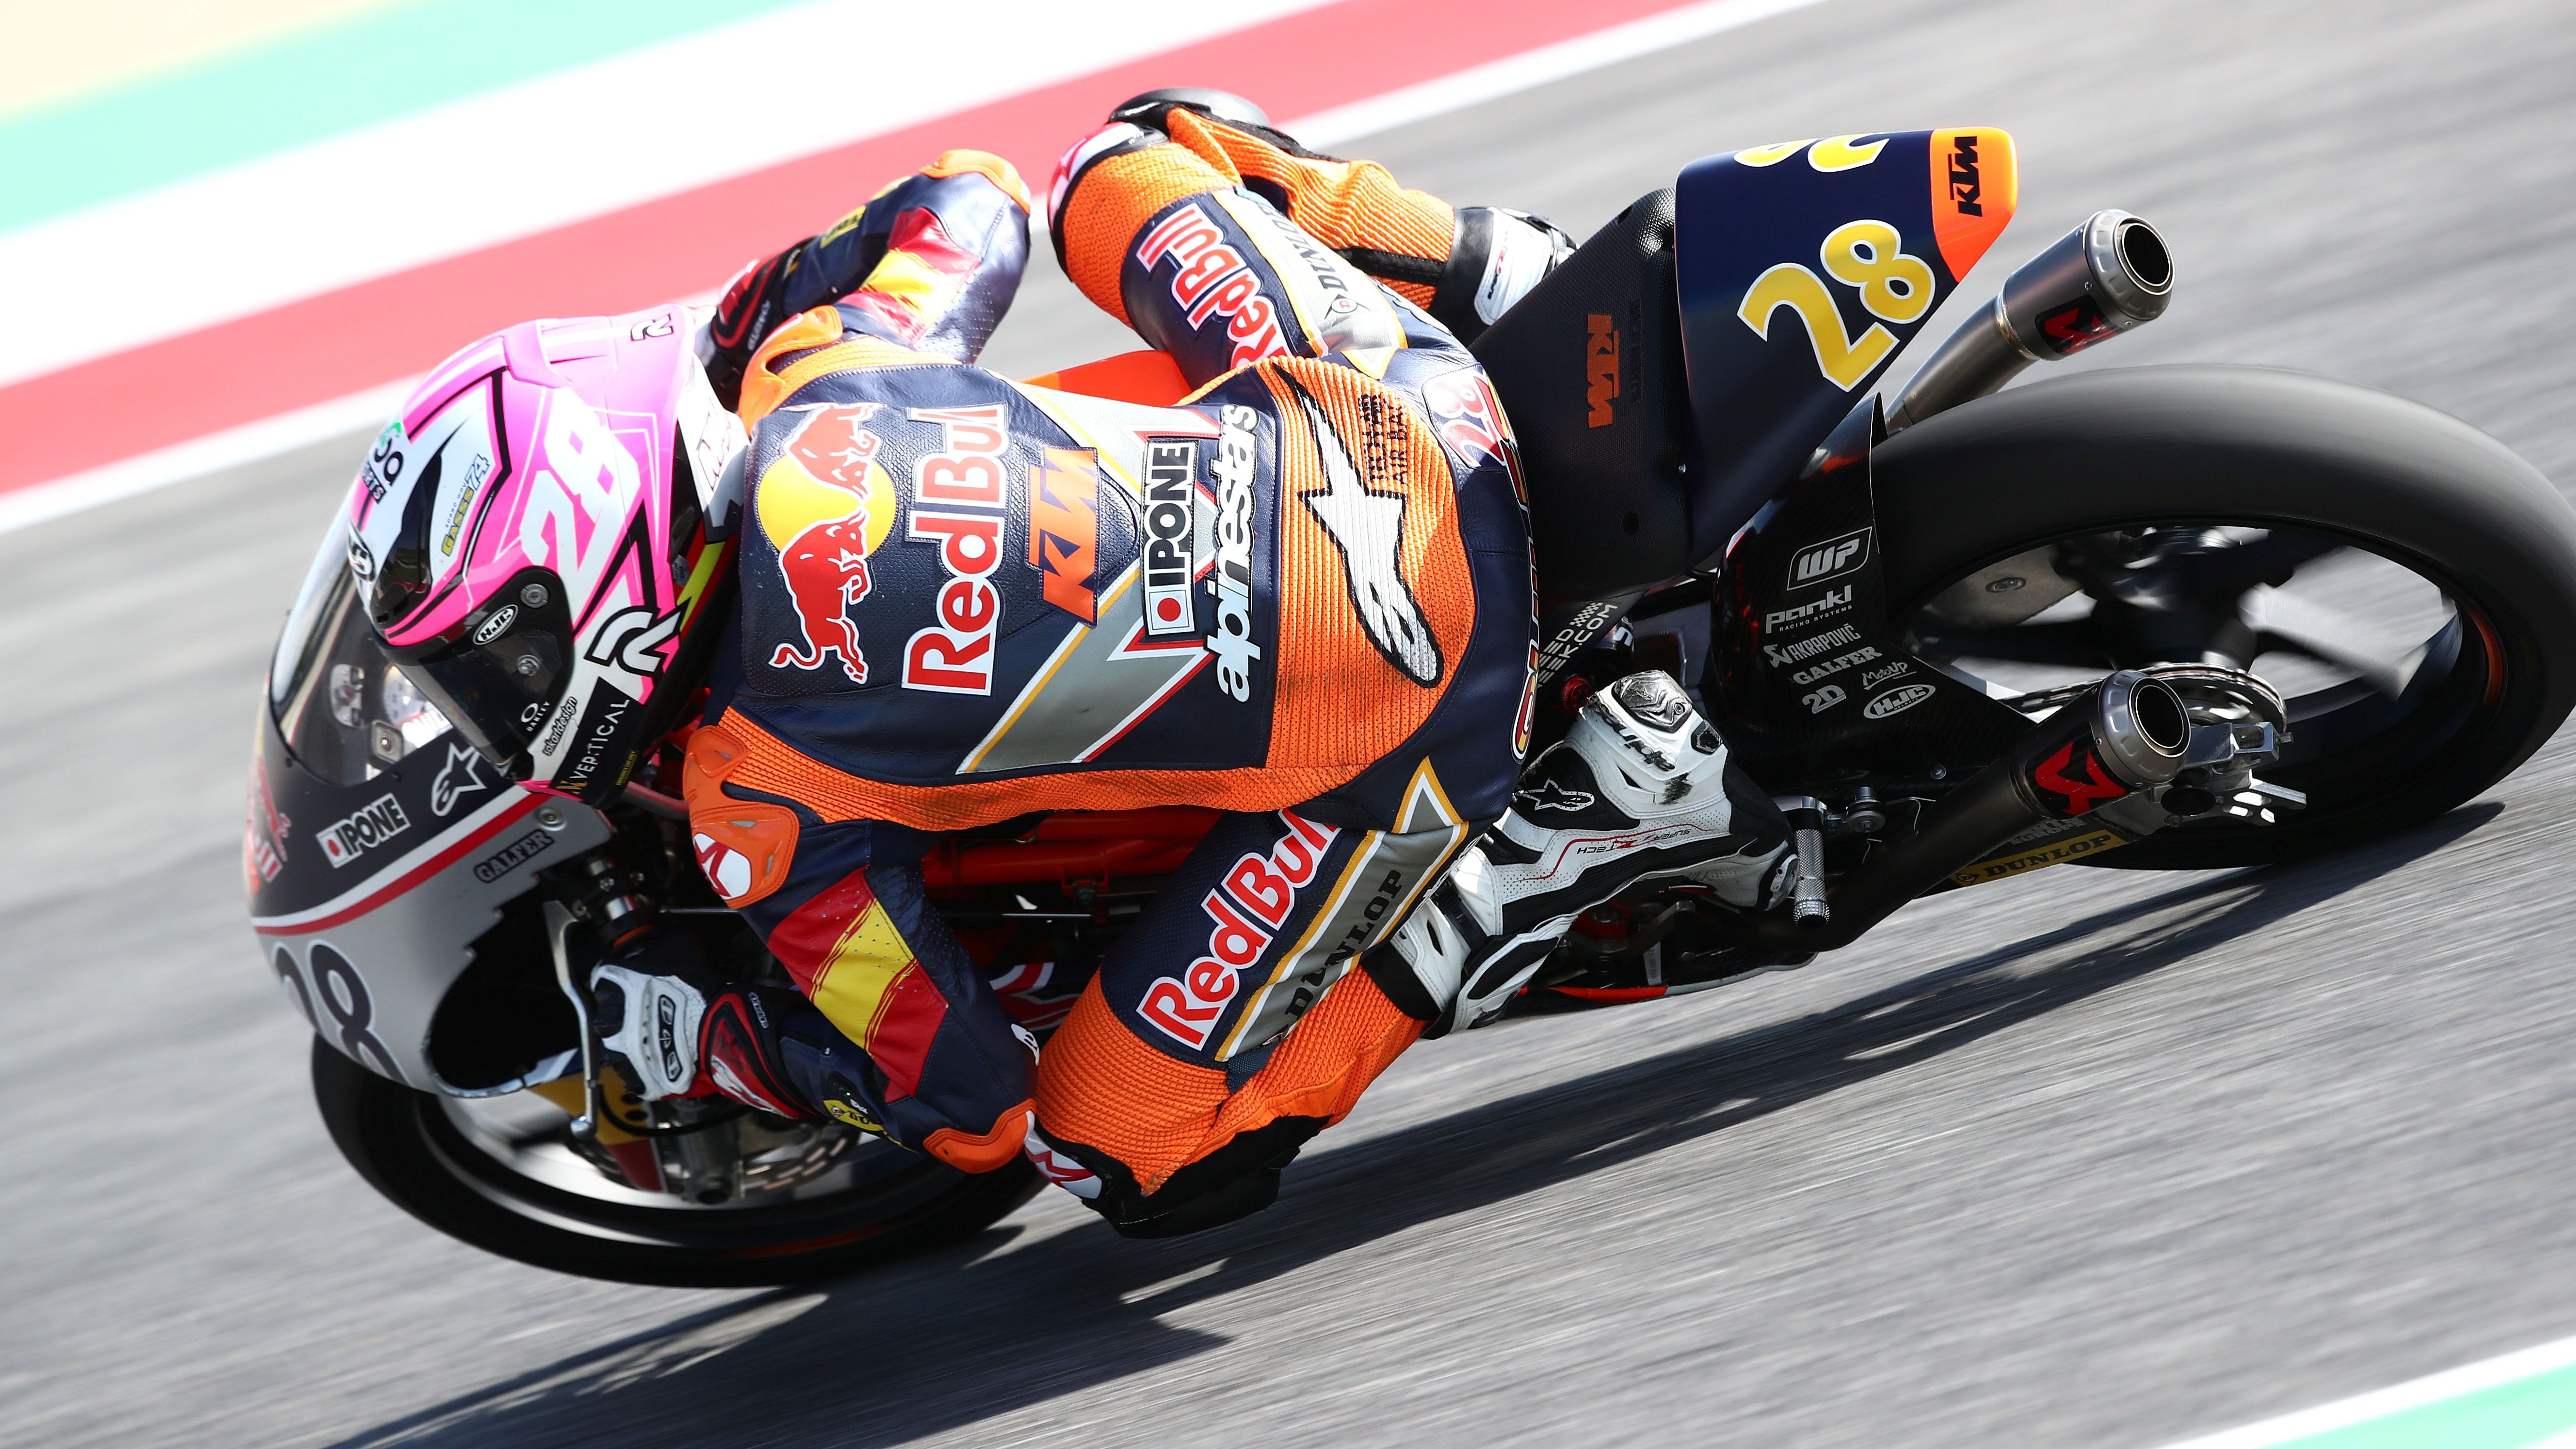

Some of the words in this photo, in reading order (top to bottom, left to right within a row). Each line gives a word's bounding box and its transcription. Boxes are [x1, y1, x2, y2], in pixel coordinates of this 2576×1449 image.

[1948, 136, 1983, 217] KTM
[1136, 202, 1249, 311] Bull
[1256, 202, 1349, 292] DUNLOP
[1737, 219, 1936, 392] 28
[1587, 314, 1619, 428] KTM
[1389, 447, 1408, 484] AIR
[520, 386, 641, 633] 28
[1027, 445, 1096, 624] KTM
[1150, 444, 1192, 587] IPONE
[1206, 405, 1261, 702] alpinestars
[1797, 538, 1860, 581] WP
[901, 510, 1005, 696] Red
[1779, 619, 1810, 632] RACING
[1814, 604, 1853, 621] SYSTEMS
[1538, 603, 1618, 688] EEK.COM
[1539, 629, 1573, 667] EED
[1793, 646, 1883, 685] GALFER
[1802, 684, 1847, 715] 2D
[1873, 686, 1927, 716] HJC
[336, 799, 405, 857] IPONE
[474, 829, 555, 884] GALFER
[1577, 845, 1619, 855] TECH
[1653, 828, 1692, 842] SUPER
[1983, 833, 2112, 878] DUNLOP
[1136, 888, 1273, 1051] Red
[1284, 869, 1403, 1019] DUNLOP
